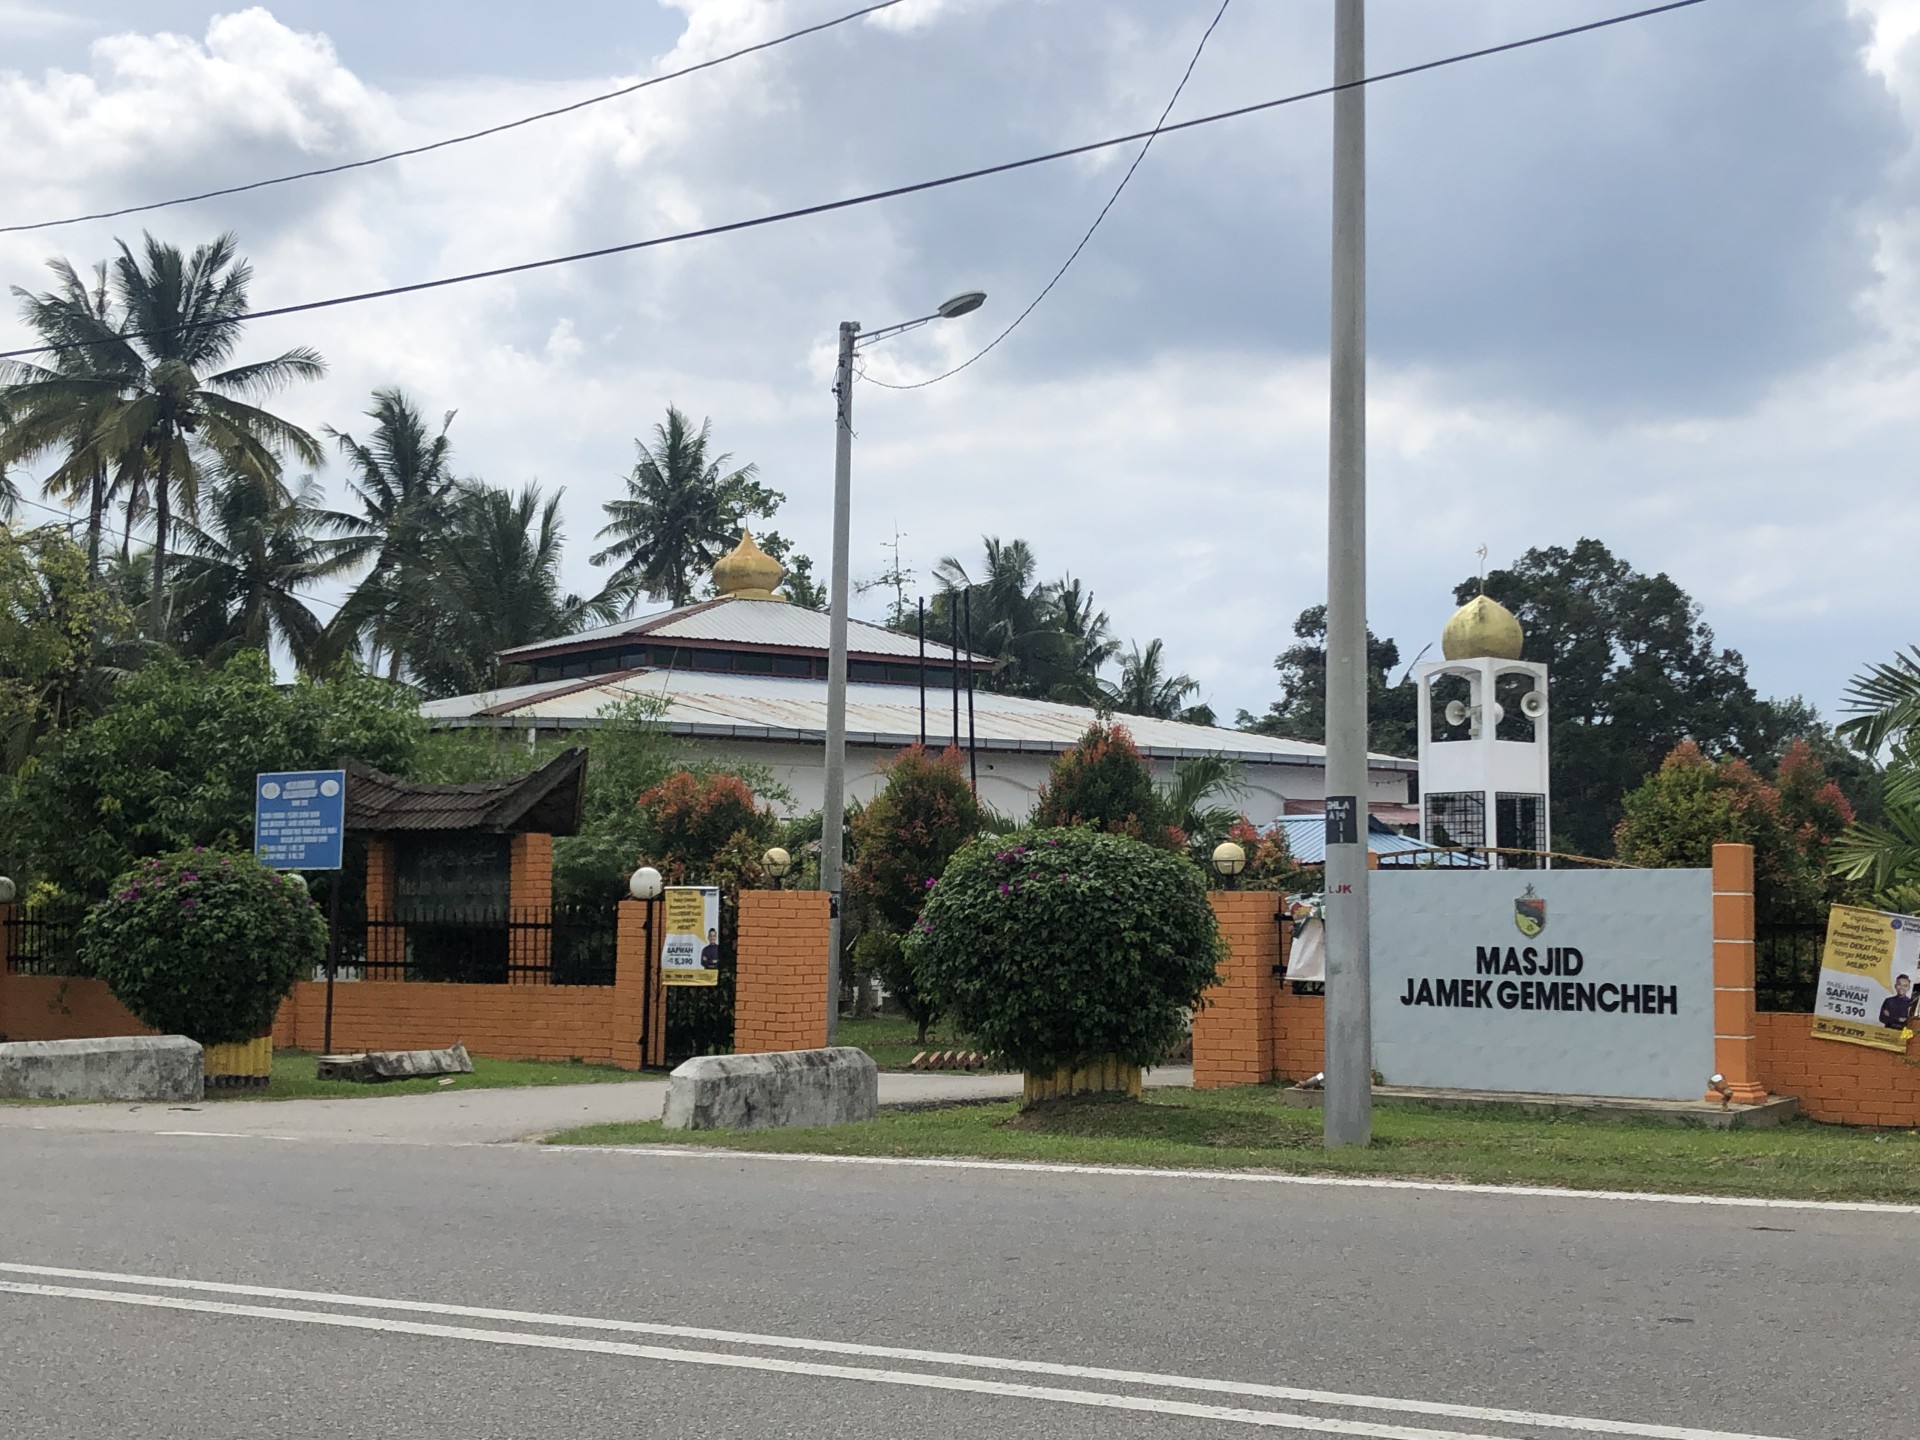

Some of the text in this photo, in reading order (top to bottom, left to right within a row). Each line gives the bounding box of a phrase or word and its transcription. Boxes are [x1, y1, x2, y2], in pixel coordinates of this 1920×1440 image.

[1476, 946, 1584, 976] MASJID
[1400, 978, 1678, 1015] JAMEK GEMENCHEH
[1825, 987, 1869, 1002] SAFWAH
[1834, 1004, 1866, 1017] 5,390
